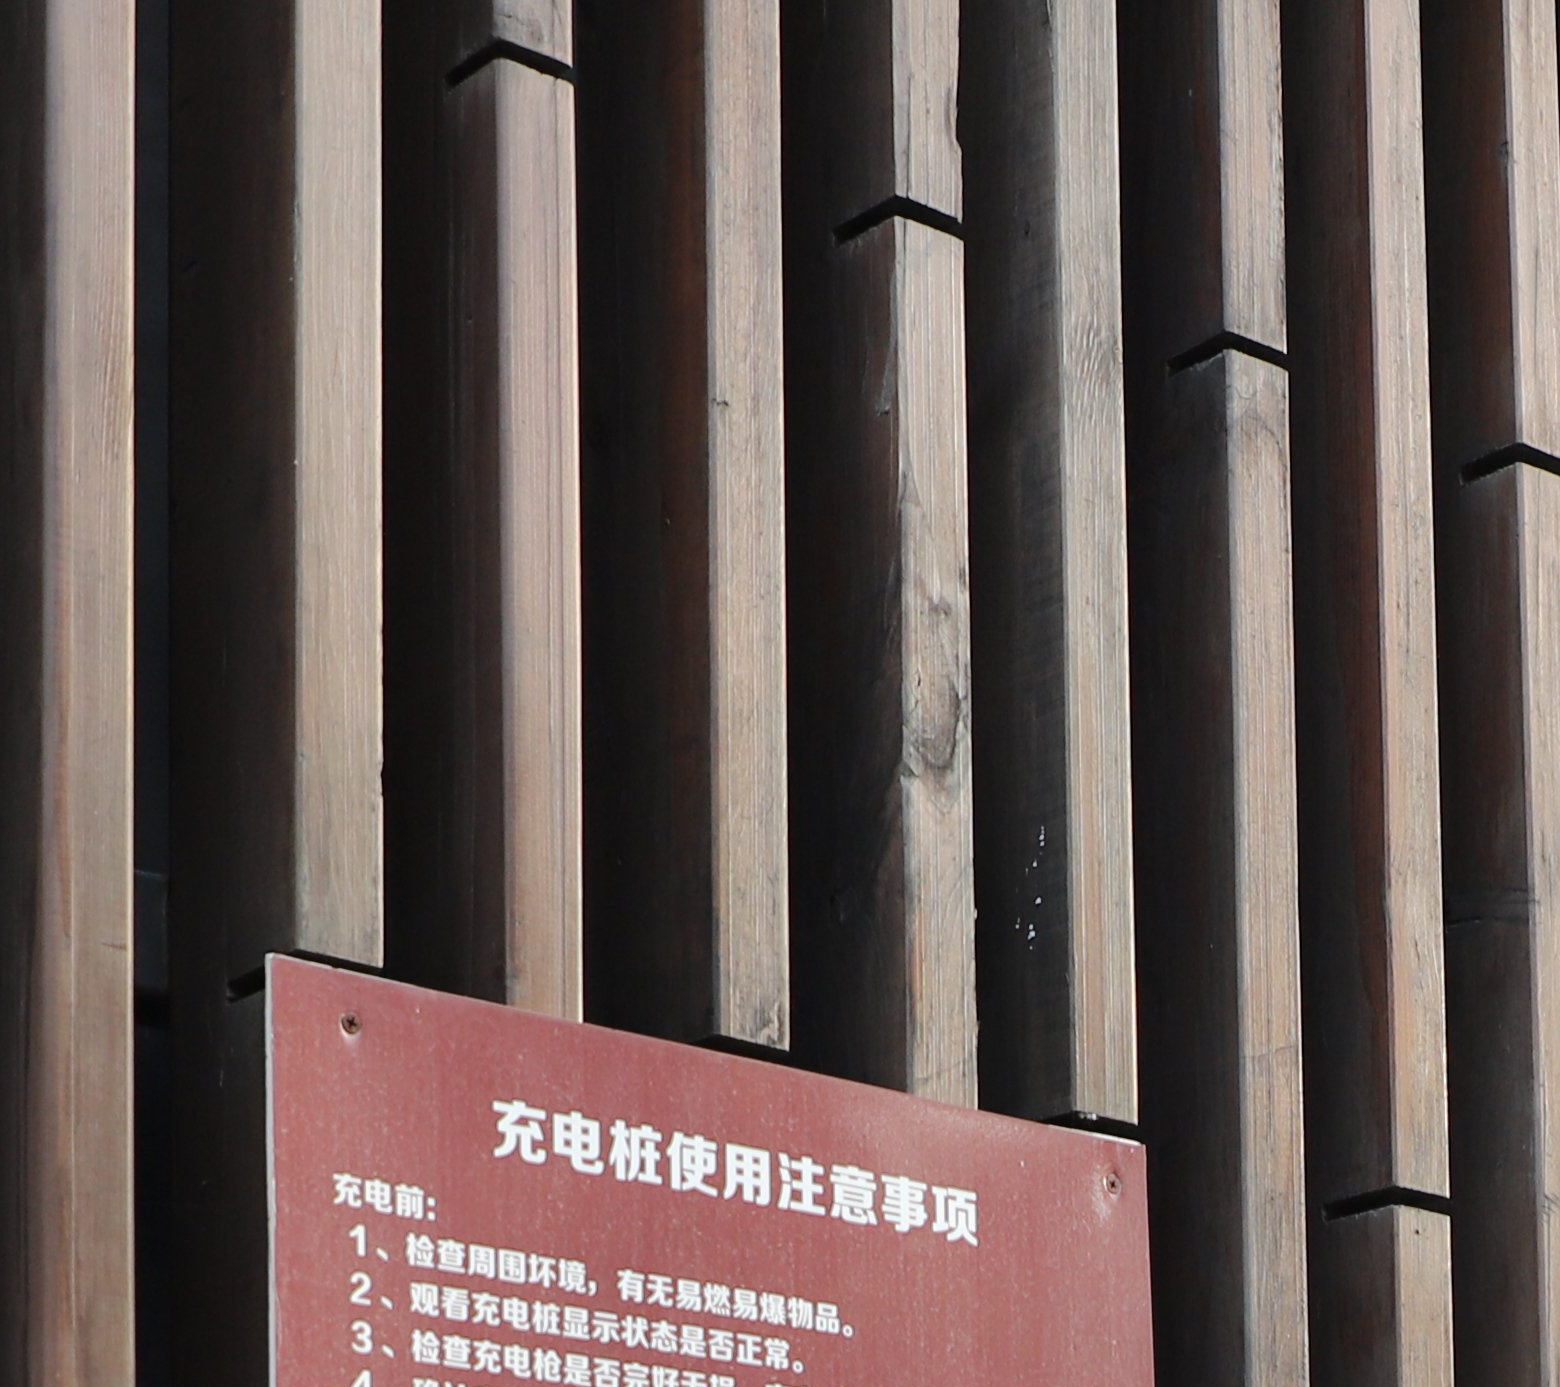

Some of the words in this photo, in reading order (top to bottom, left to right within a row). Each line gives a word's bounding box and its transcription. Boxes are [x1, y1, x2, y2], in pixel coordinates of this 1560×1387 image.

[332, 1172, 438, 1221] 充电前：
[492, 1099, 980, 1247] 充电桩使用注意事项
